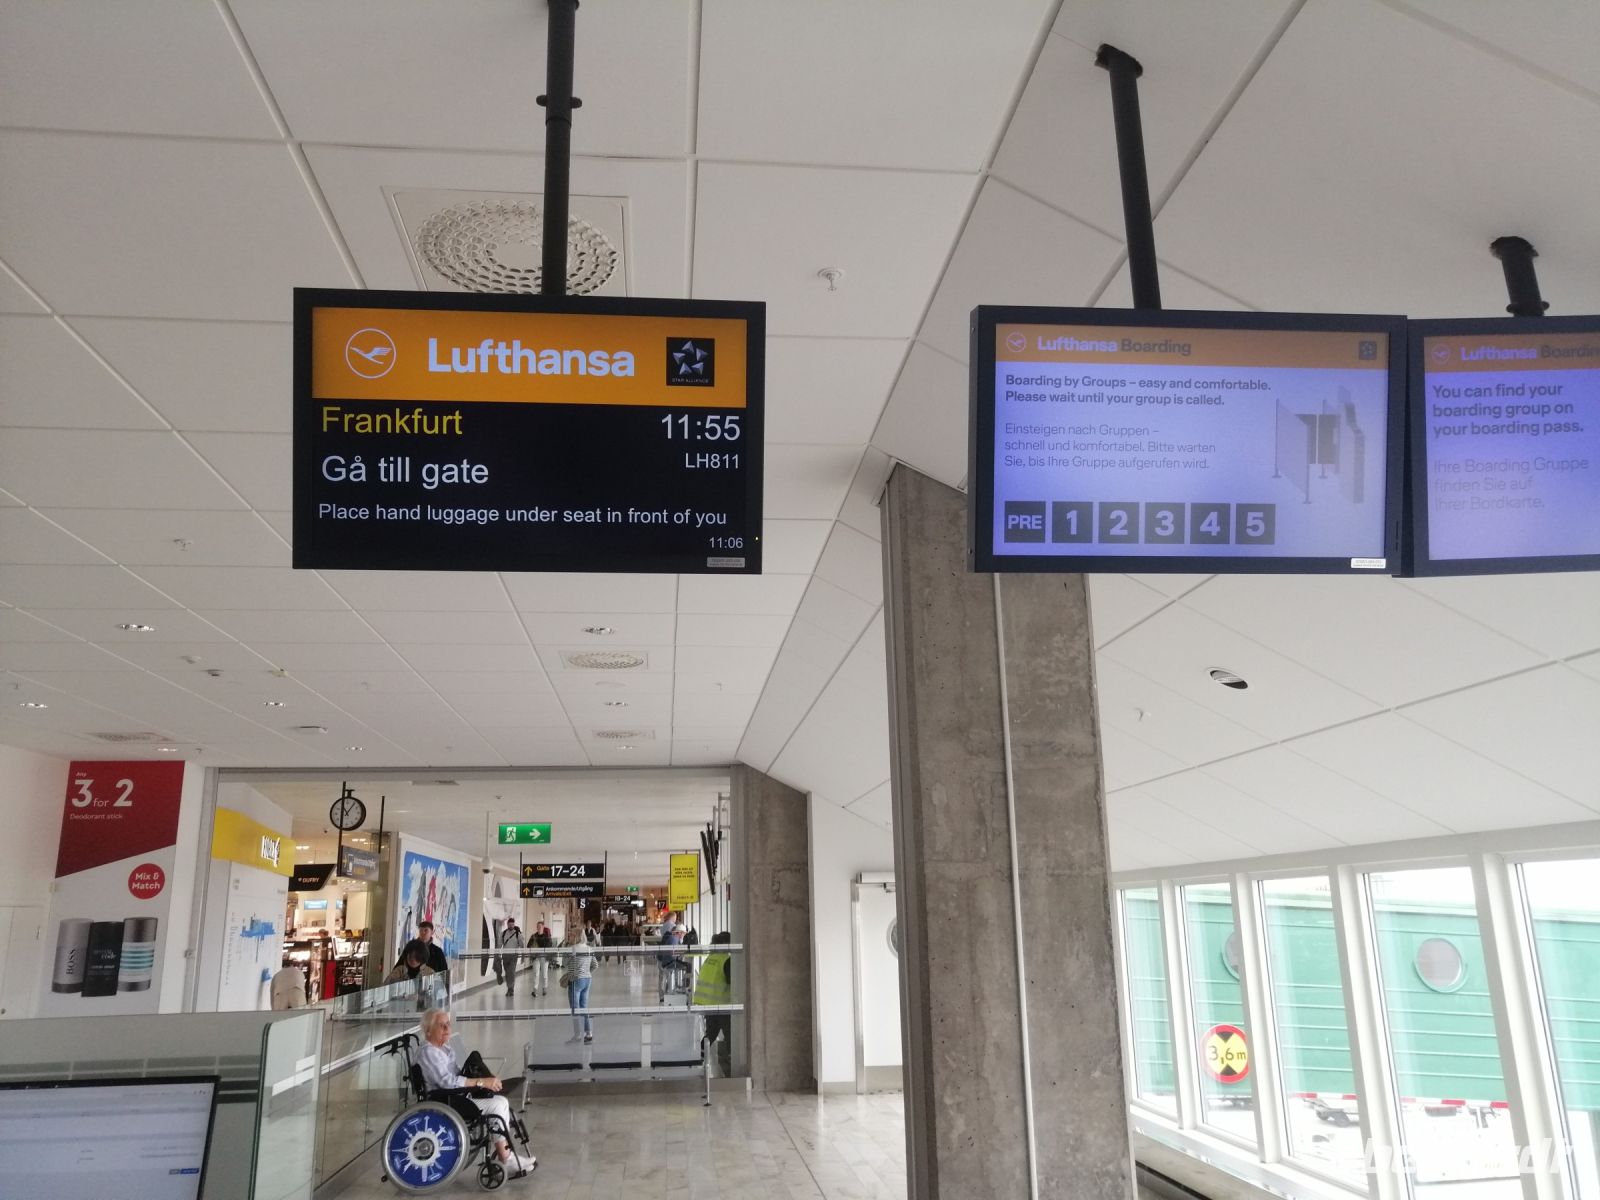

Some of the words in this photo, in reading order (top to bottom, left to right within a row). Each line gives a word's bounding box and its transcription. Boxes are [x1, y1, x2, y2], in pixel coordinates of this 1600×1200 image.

[1037, 336, 1118, 352] Lufthansa
[1121, 339, 1191, 356] Boarding
[1461, 347, 1536, 360] Lufthansa
[428, 338, 634, 376] Lufthansa
[1006, 374, 1061, 388] Boarding
[1064, 375, 1079, 388] by
[1081, 376, 1126, 388] Groups
[1139, 380, 1166, 390] easy
[1169, 379, 1192, 389] and
[1195, 379, 1271, 390] comfortable.
[1005, 391, 1046, 404] Please
[1048, 392, 1076, 404] wait
[1078, 392, 1105, 404] until
[1107, 394, 1133, 407] your
[1135, 395, 1172, 408] group
[1174, 394, 1184, 406] is
[1186, 394, 1225, 406] called.
[1433, 385, 1460, 398] You
[1464, 386, 1492, 397] can
[1496, 384, 1525, 396] find
[1529, 385, 1563, 399] your
[1433, 404, 1502, 418] boarding
[1506, 404, 1551, 418] group
[1554, 403, 1574, 414] on
[322, 406, 463, 434] Frankfurt
[660, 414, 740, 440] 11:55
[1005, 423, 1066, 436] Einsteigen
[1068, 425, 1096, 435] nach
[1099, 425, 1149, 437] Gruppen
[1433, 425, 1470, 438] your
[1471, 421, 1540, 436] boarding
[1544, 422, 1584, 435] pass.
[1004, 440, 1045, 451] schnell
[1048, 441, 1070, 451] und
[1073, 441, 1144, 452] komfortabel.
[1148, 442, 1174, 452] Bitte
[1178, 443, 1216, 453] warten
[685, 453, 739, 469] LH811
[1004, 456, 1025, 468] Sie,
[1028, 456, 1045, 466] bis
[1048, 456, 1069, 466] Ihre
[1072, 456, 1116, 468] Gruppe
[1118, 457, 1180, 469] aufgerufen
[1183, 458, 1208, 469] wird.
[1465, 459, 1530, 474] Boarding
[1535, 457, 1589, 472] Gruppe
[322, 455, 367, 482] Gå
[378, 457, 410, 482] till
[421, 461, 489, 489] gate
[319, 503, 370, 520] Place
[376, 504, 420, 521] hand
[427, 505, 499, 525] luggage
[506, 506, 557, 522] under
[563, 508, 601, 523] seat
[607, 508, 622, 523] in
[628, 508, 668, 524] front
[673, 508, 691, 524] of
[696, 511, 726, 528] you
[1008, 514, 1042, 530] PRE
[1066, 511, 1078, 536] 1
[1110, 512, 1128, 536] 2
[1155, 512, 1174, 536] 3
[1200, 512, 1220, 536] 4
[1246, 512, 1264, 537] 5
[710, 537, 743, 548] 11:06
[72, 779, 94, 807] 3
[94, 799, 110, 807] for
[113, 779, 134, 806] 2
[66, 949, 78, 974] BOSS
